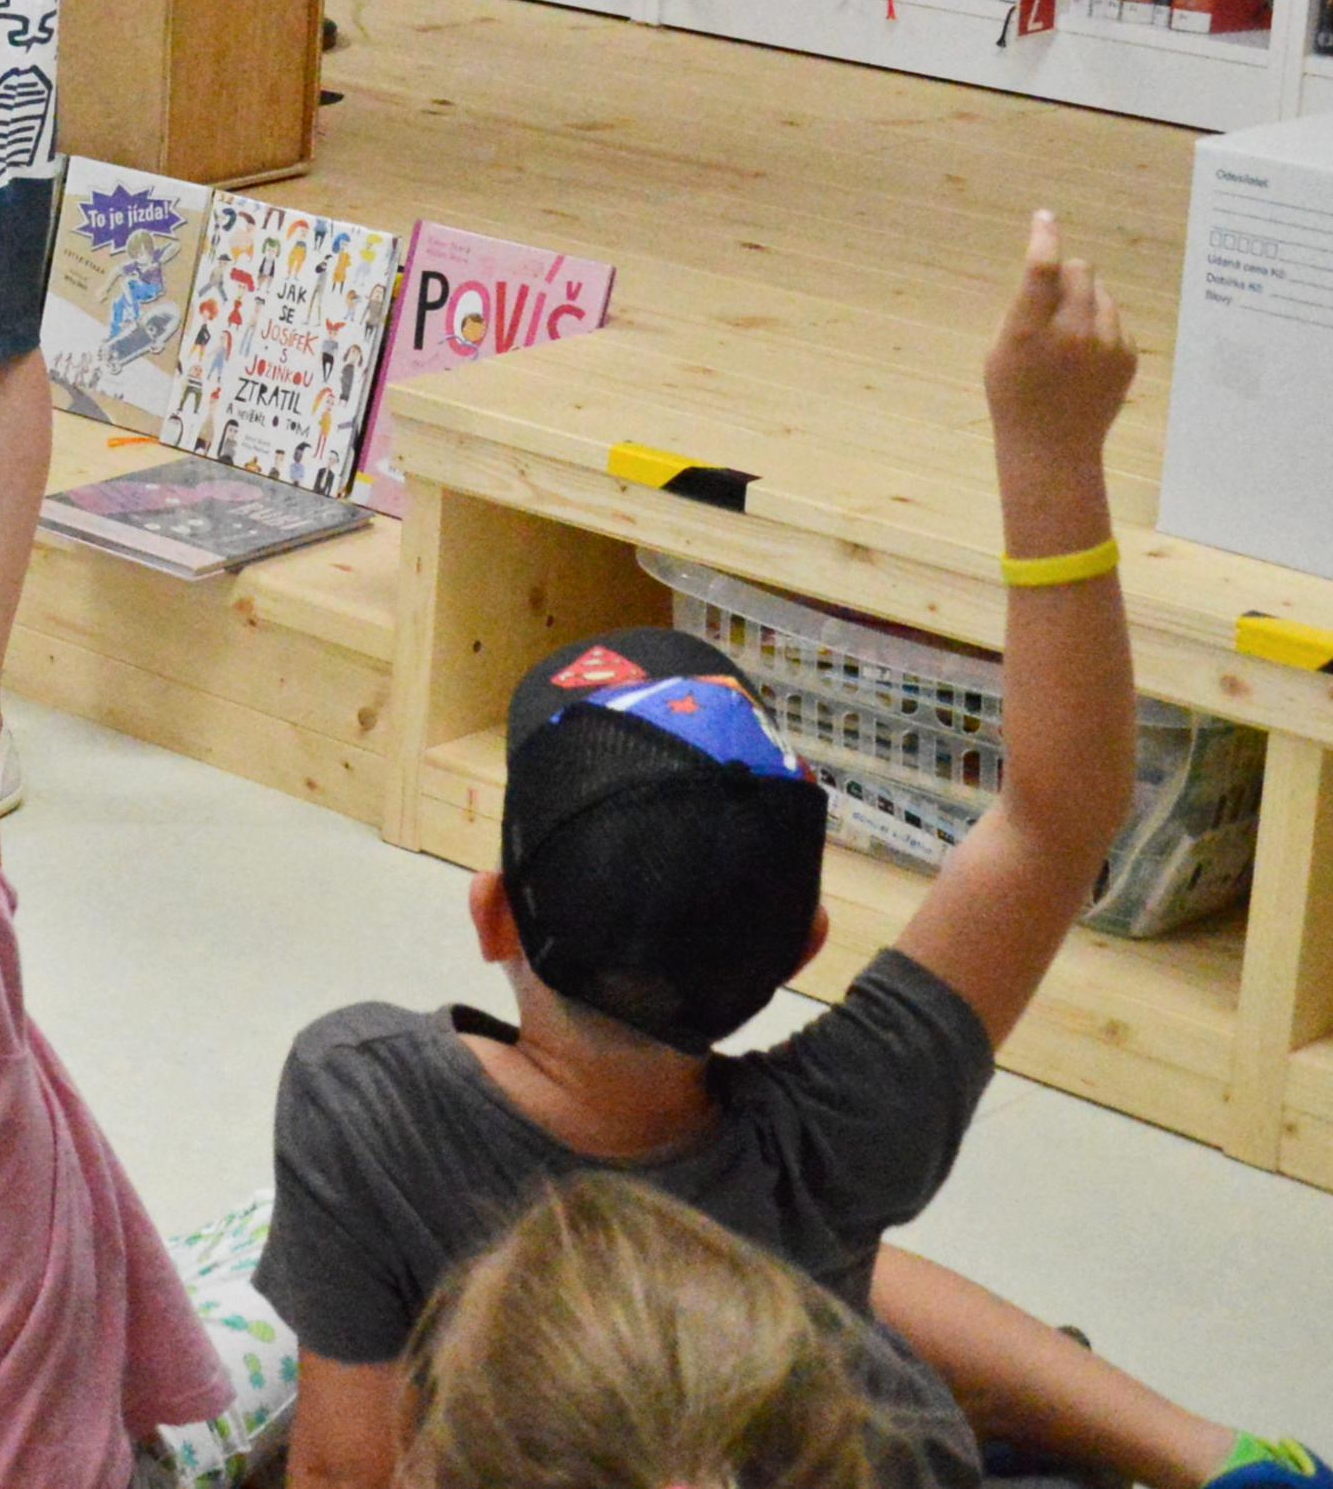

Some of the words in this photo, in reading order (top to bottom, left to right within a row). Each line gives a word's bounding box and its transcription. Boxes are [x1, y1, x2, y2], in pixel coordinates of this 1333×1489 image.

[88, 209, 106, 229] To
[109, 207, 124, 230] je
[127, 200, 169, 228] jízda!
[276, 282, 307, 304] JAK
[278, 305, 296, 324] SE
[279, 348, 288, 365] S
[234, 376, 302, 415] ZTRATIL
[225, 402, 234, 414] A
[286, 418, 311, 439] TOM
